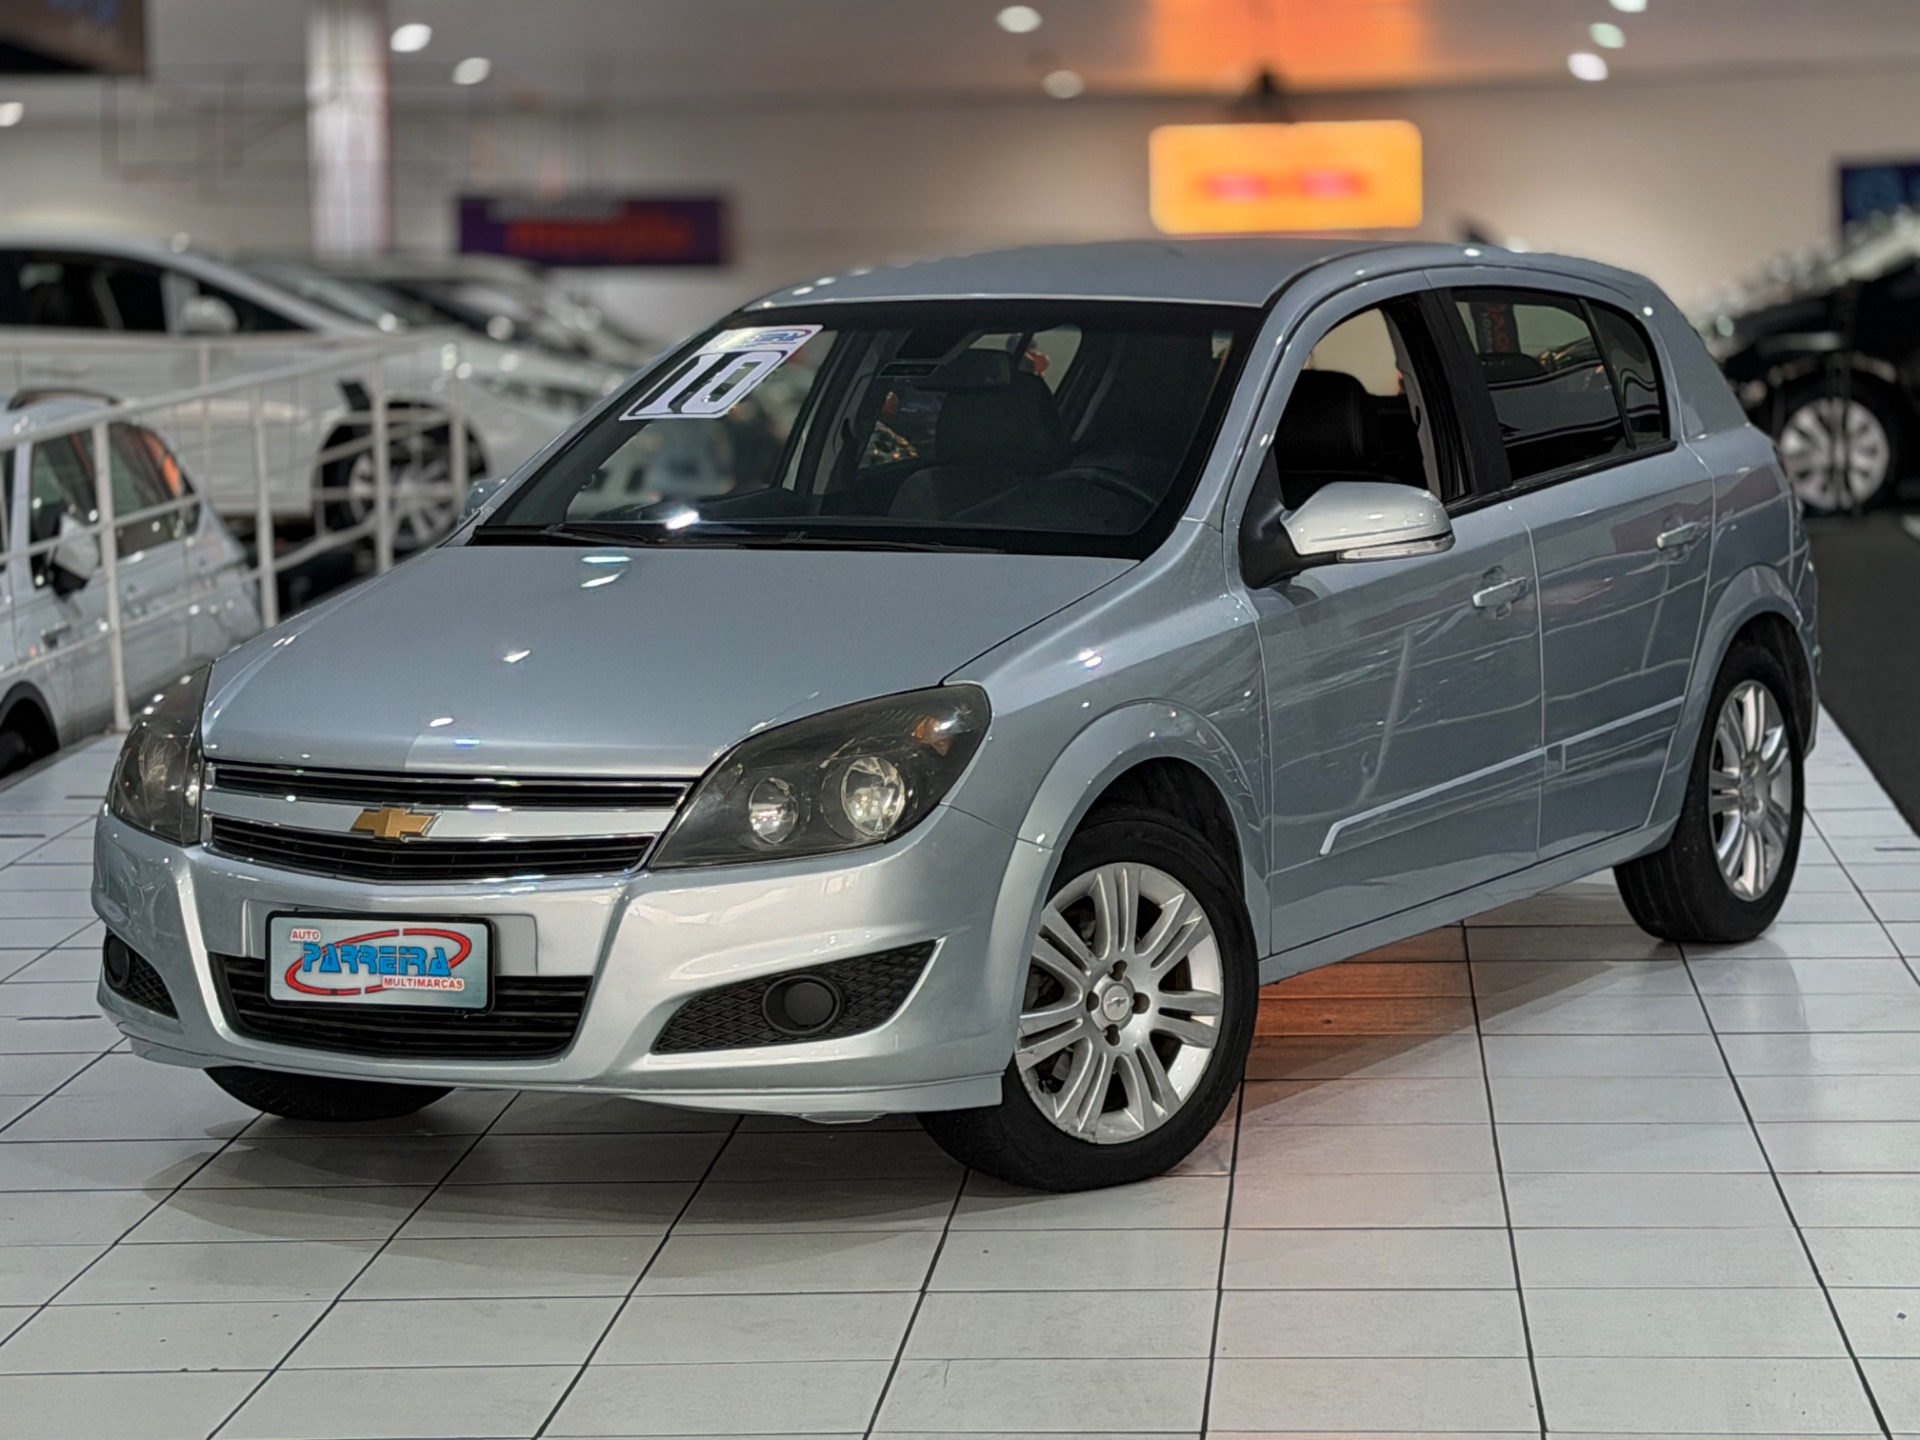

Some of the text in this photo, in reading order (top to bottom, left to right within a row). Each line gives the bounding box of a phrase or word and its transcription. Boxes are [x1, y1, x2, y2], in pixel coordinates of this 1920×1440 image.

[630, 351, 787, 415] 10
[291, 930, 320, 941] AUTO
[302, 942, 452, 977] PARREIRA
[383, 976, 464, 990] MULTIMARCAS
